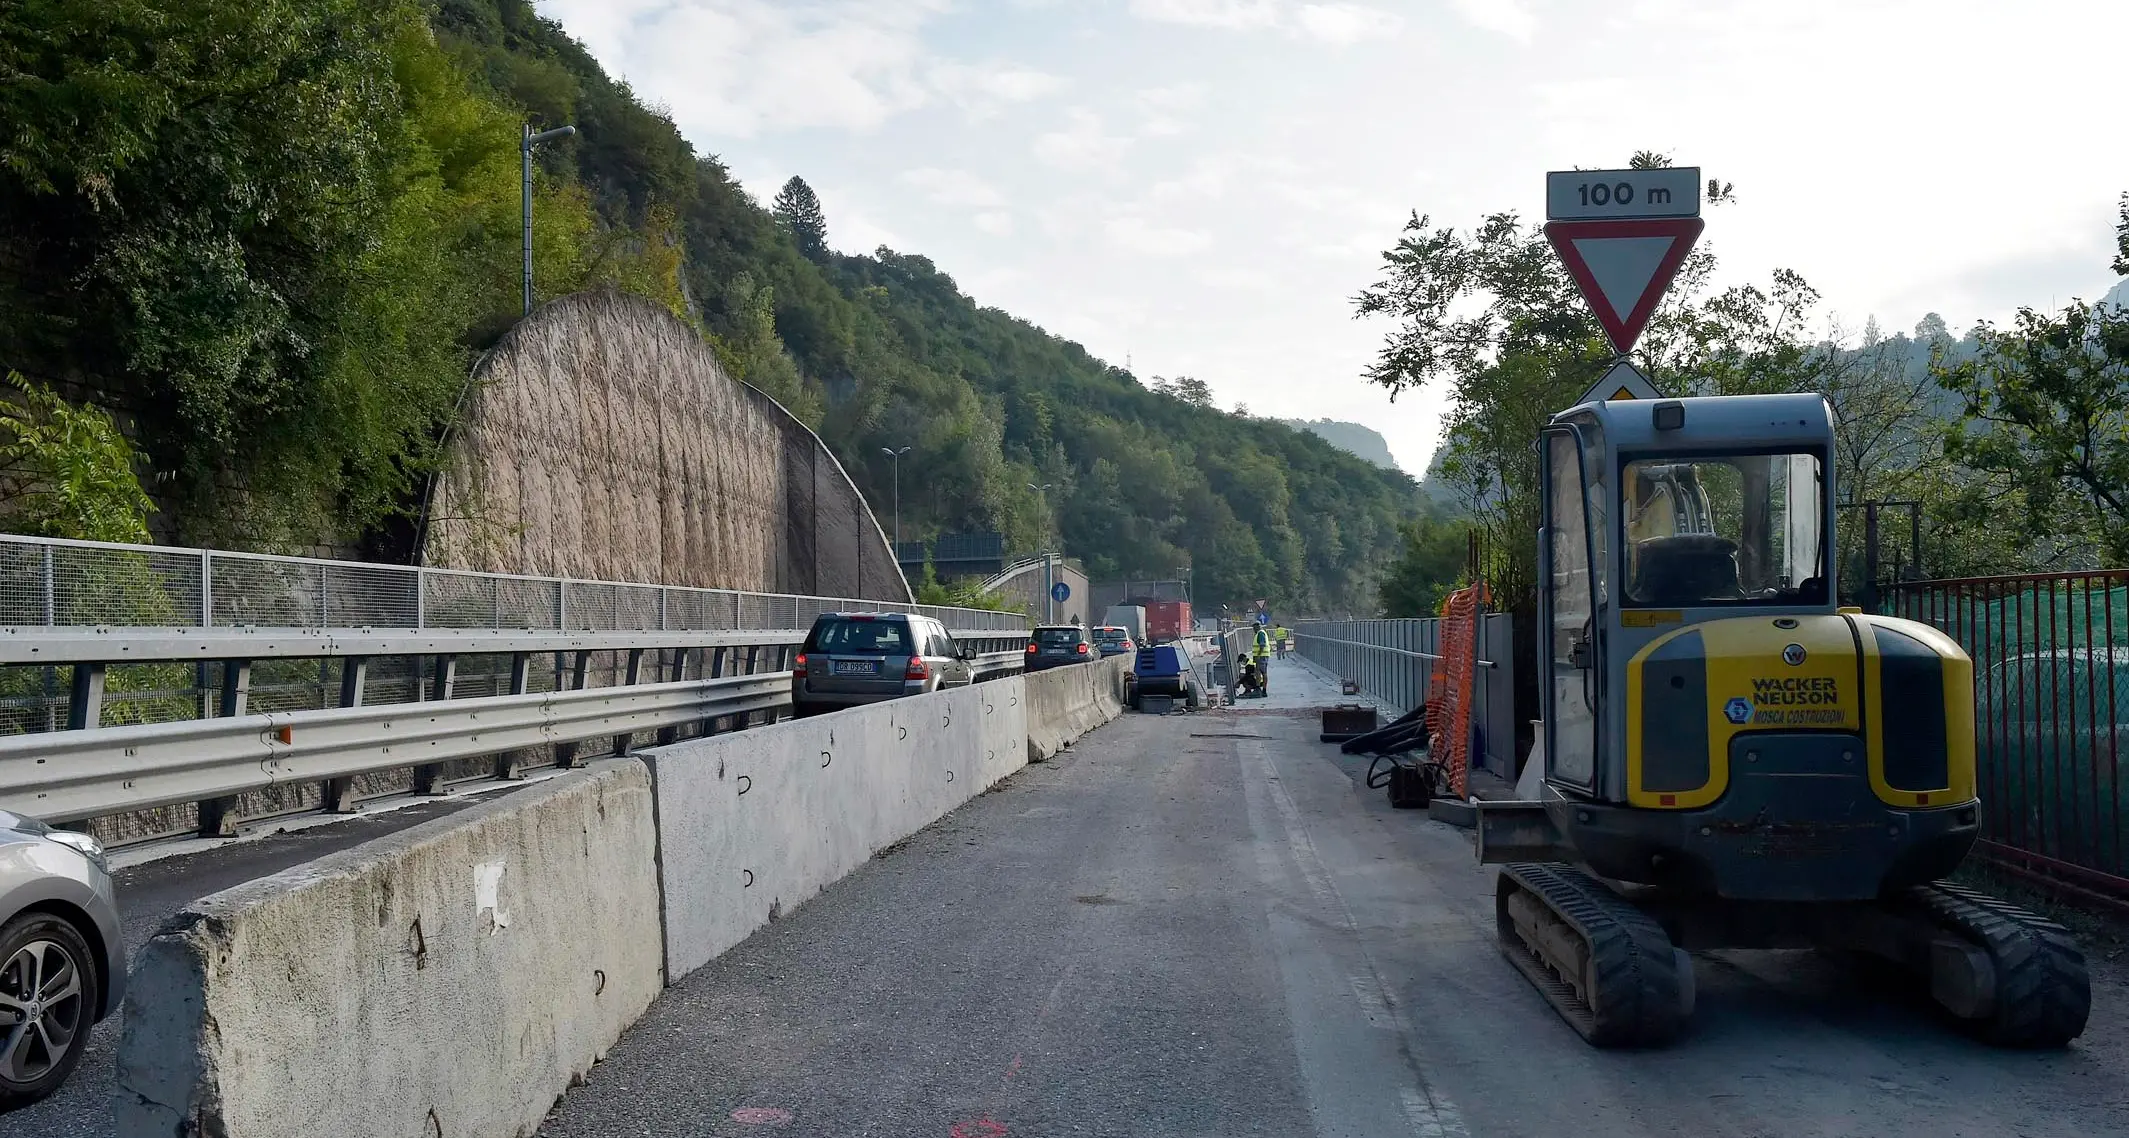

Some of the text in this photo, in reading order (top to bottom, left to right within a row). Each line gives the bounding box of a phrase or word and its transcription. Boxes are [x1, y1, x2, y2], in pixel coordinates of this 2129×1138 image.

[1578, 182, 1671, 206] 100 m
[1752, 677, 1837, 691] WACKER
[1753, 692, 1838, 705] NEUSON
[1754, 708, 1846, 724] MOSCA COSTRUZIONI
